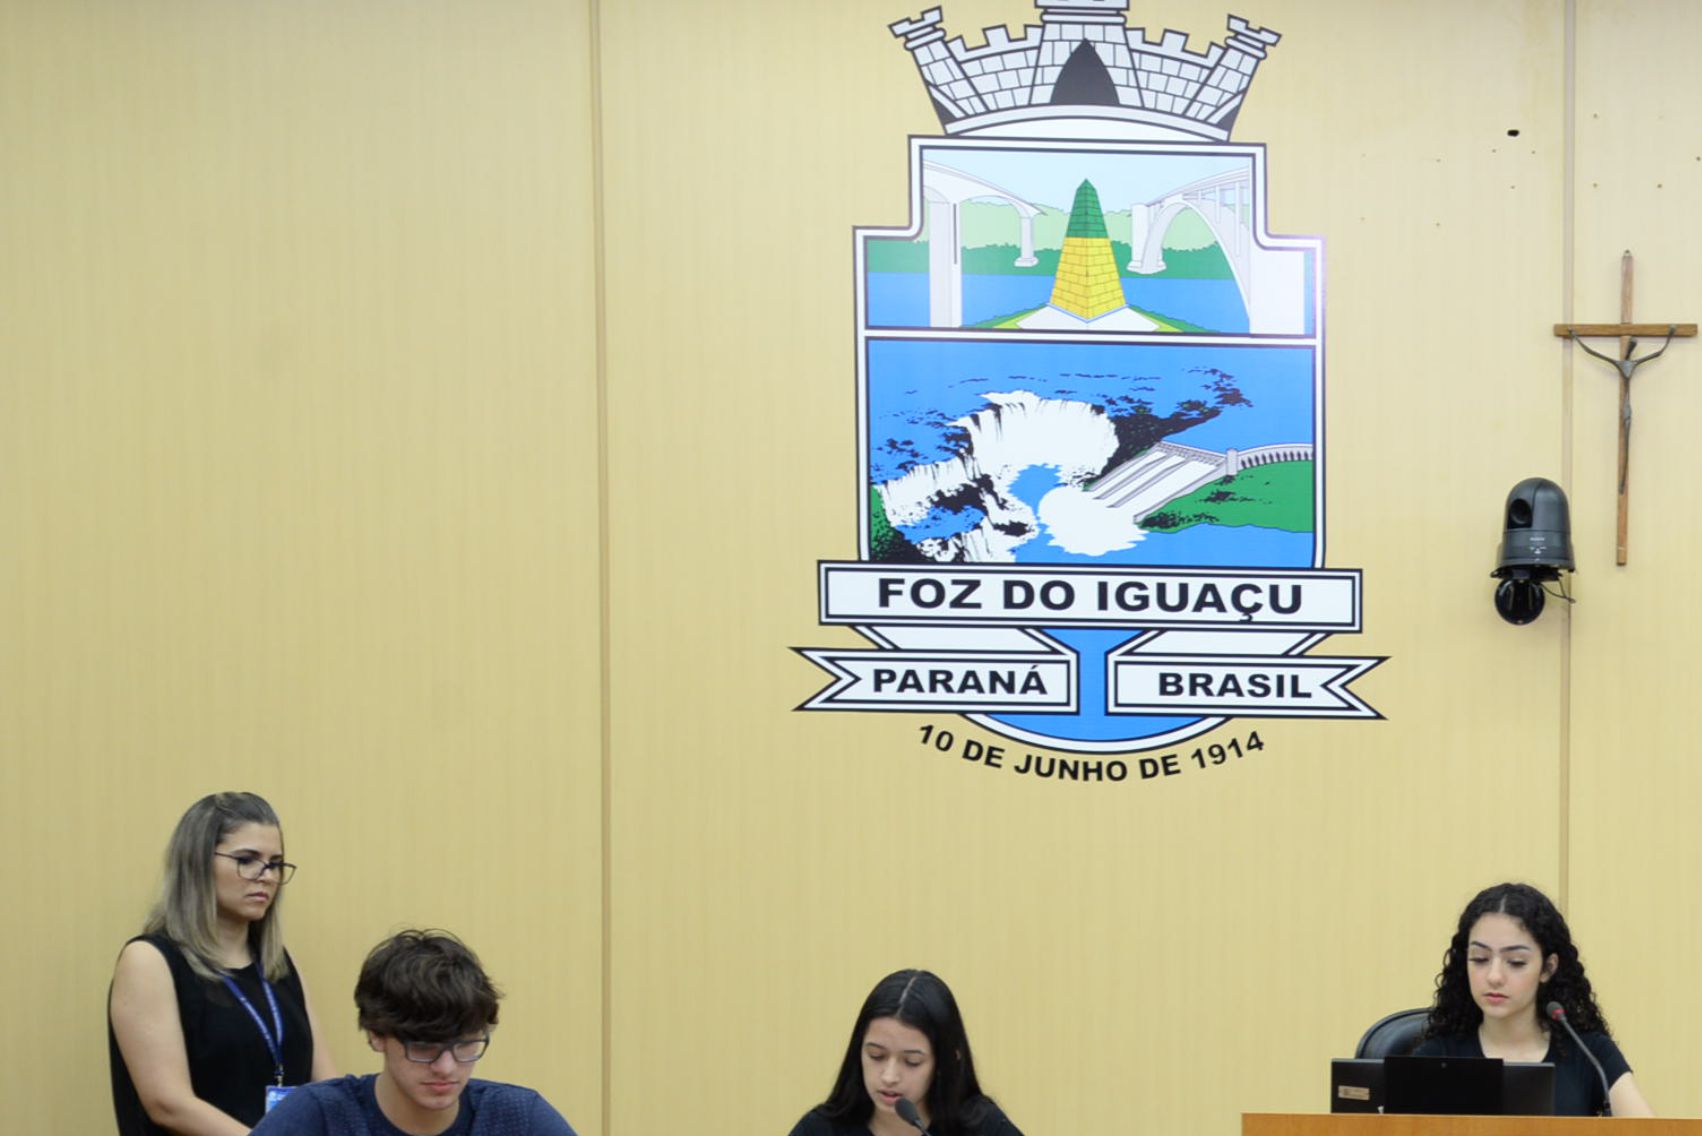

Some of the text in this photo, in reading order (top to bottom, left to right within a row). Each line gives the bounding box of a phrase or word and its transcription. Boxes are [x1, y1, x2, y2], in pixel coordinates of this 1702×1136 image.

[878, 577, 1303, 622] FOZ DO IGUAÇU
[872, 664, 1048, 695] PARANÁ
[1158, 672, 1313, 699] BRASIL
[919, 723, 1266, 782] 10 DE JUNHO DE 1914
